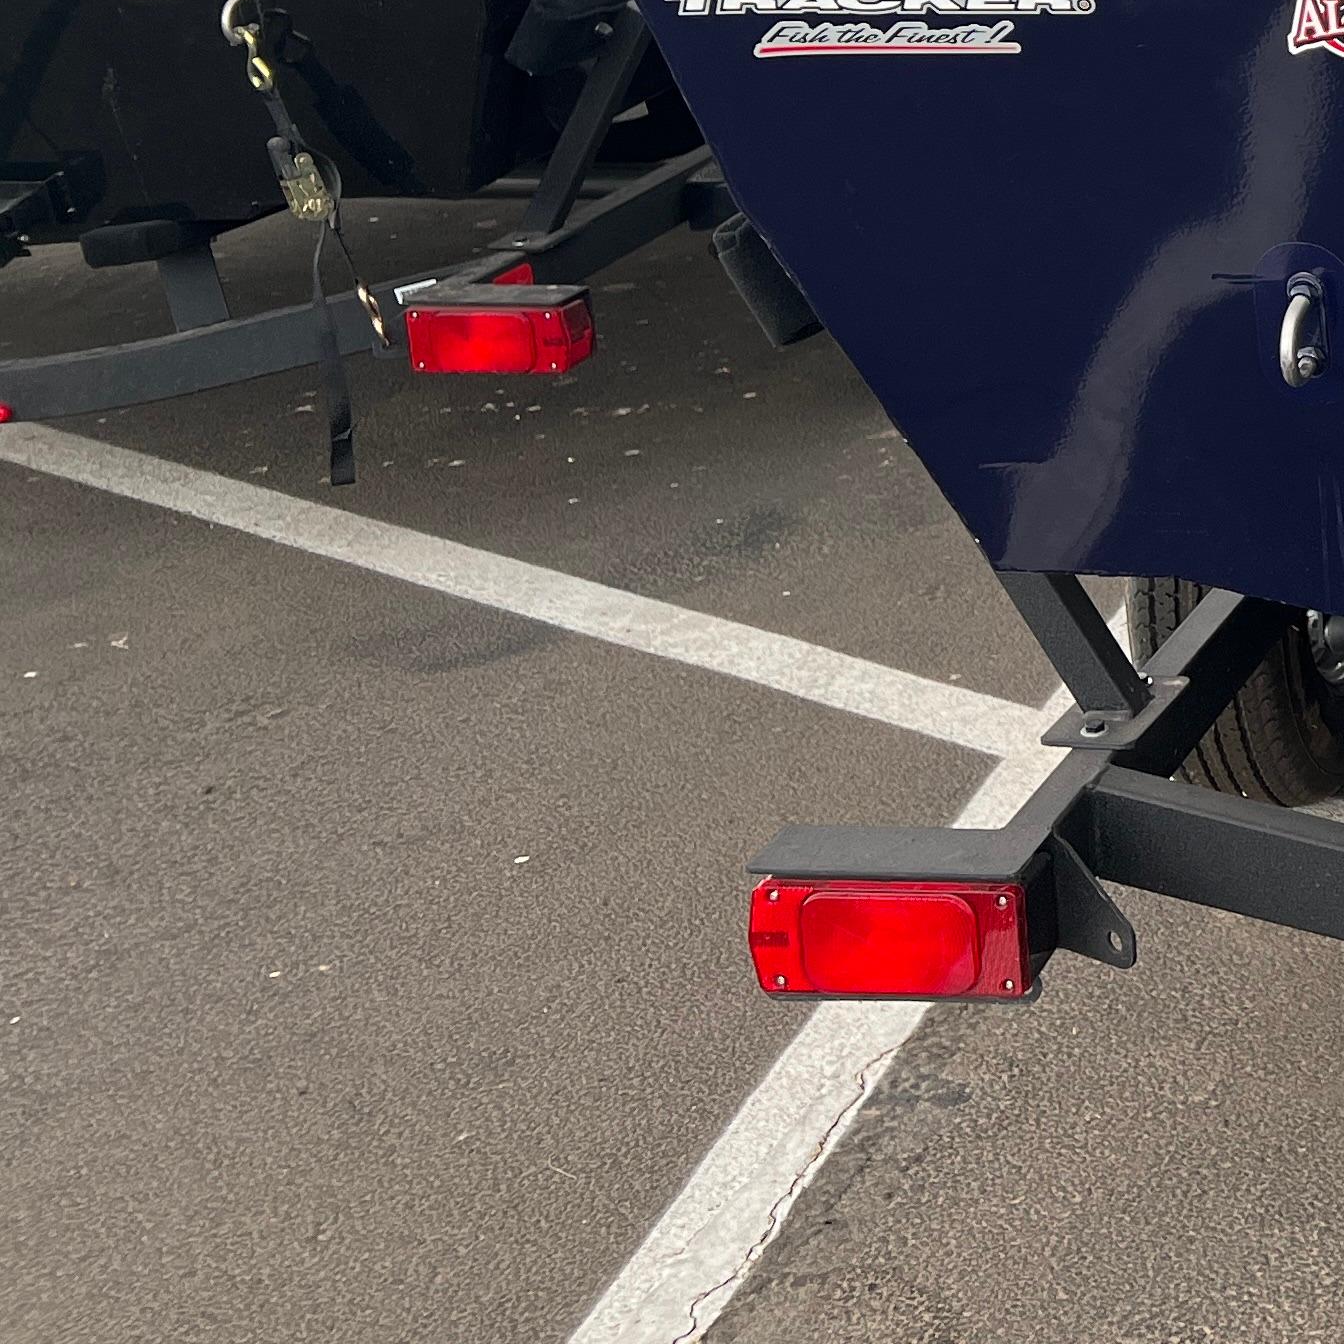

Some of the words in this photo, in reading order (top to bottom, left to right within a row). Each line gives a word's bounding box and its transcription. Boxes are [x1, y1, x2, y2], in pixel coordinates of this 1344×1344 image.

[768, 25, 829, 43] Fish
[838, 25, 880, 43] the
[885, 25, 973, 44] Finest
